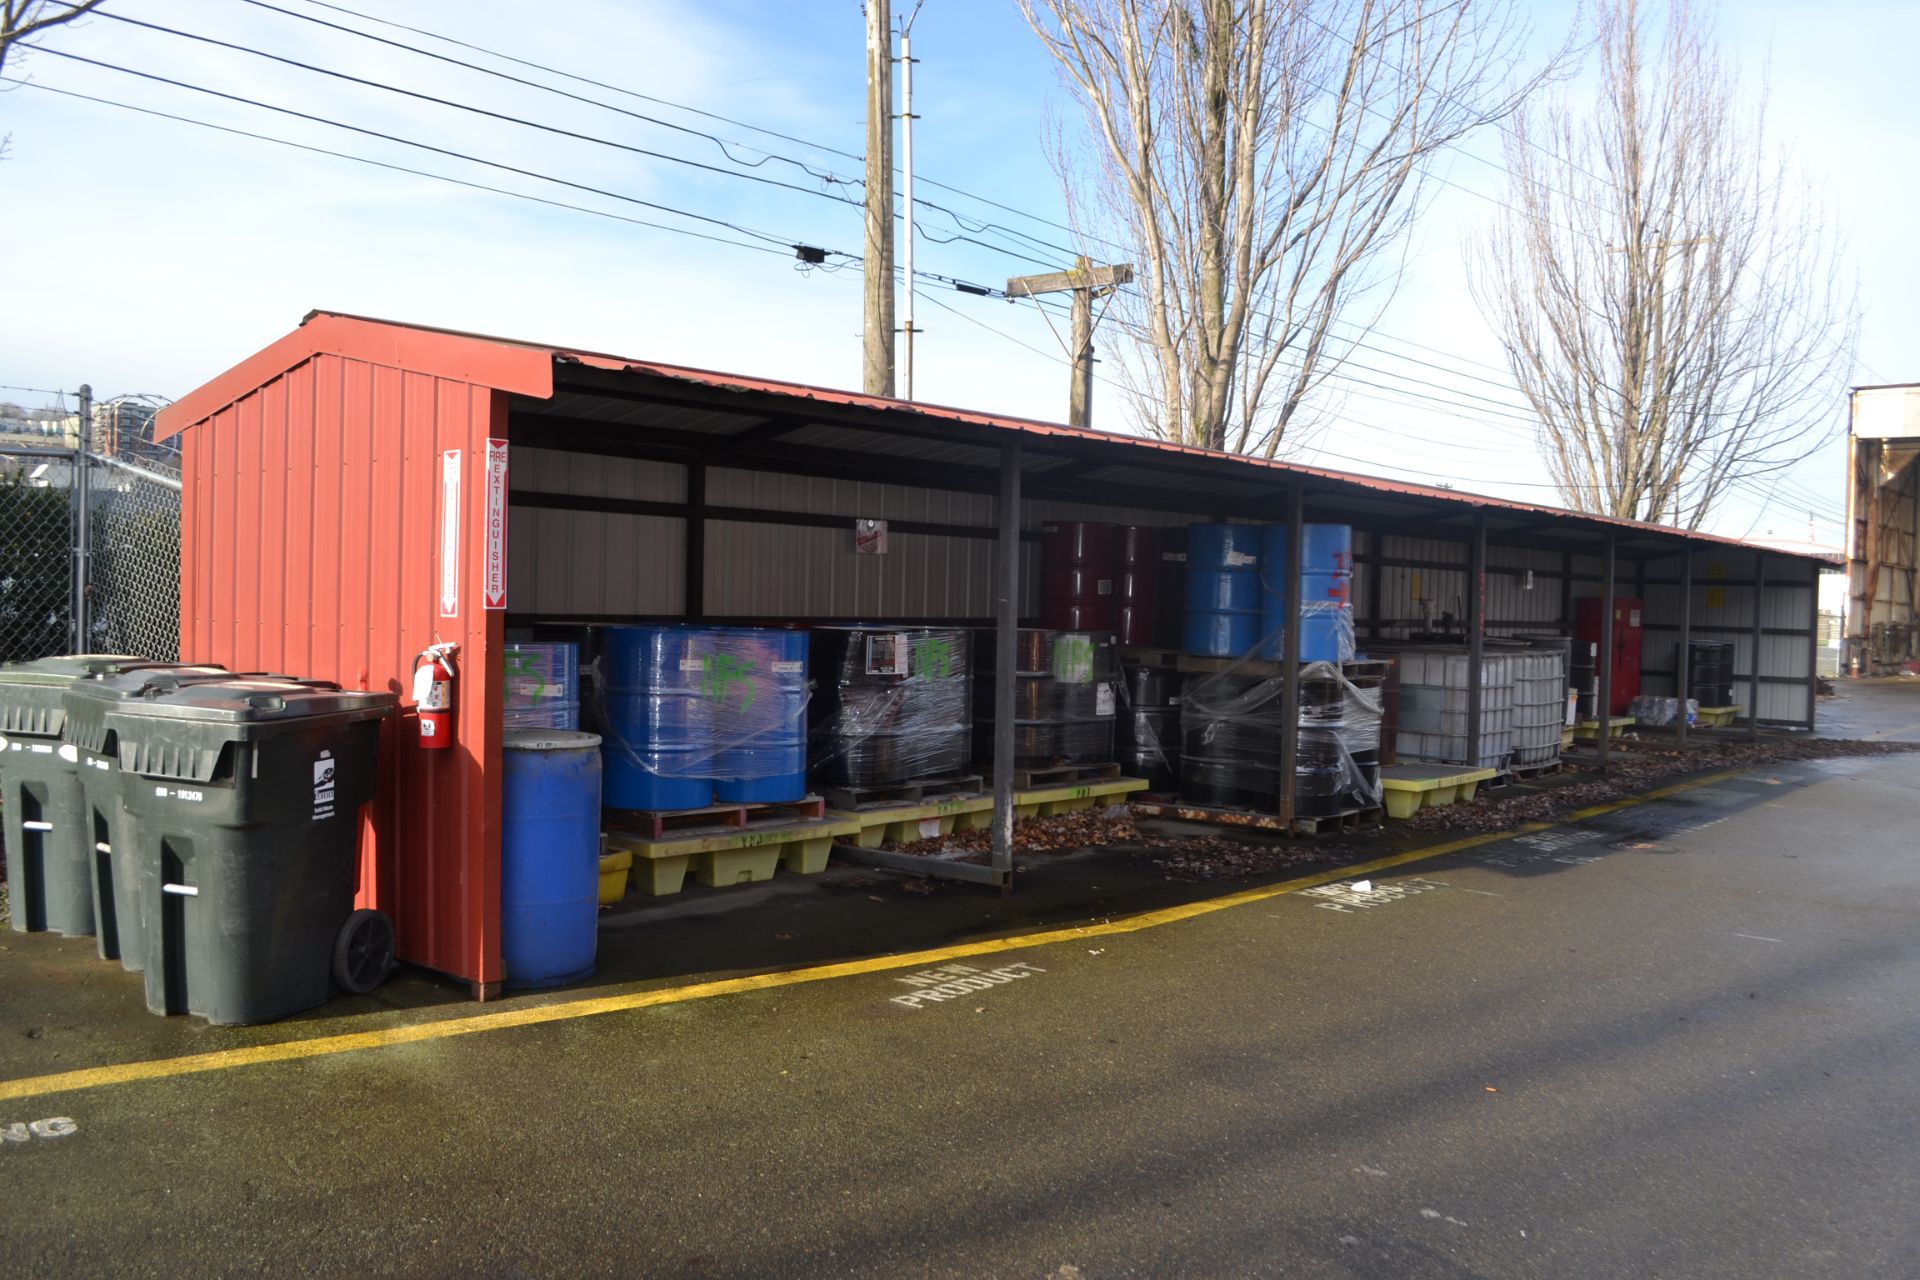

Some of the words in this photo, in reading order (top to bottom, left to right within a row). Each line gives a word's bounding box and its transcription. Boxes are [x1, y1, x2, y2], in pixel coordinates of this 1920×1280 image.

[489, 450, 507, 463] FIRE
[491, 464, 501, 593] EXTINGUISHER
[503, 650, 545, 708] FS
[701, 650, 756, 716] NFS
[889, 962, 1048, 1008] PRODUCT
[894, 963, 981, 987] NEW
